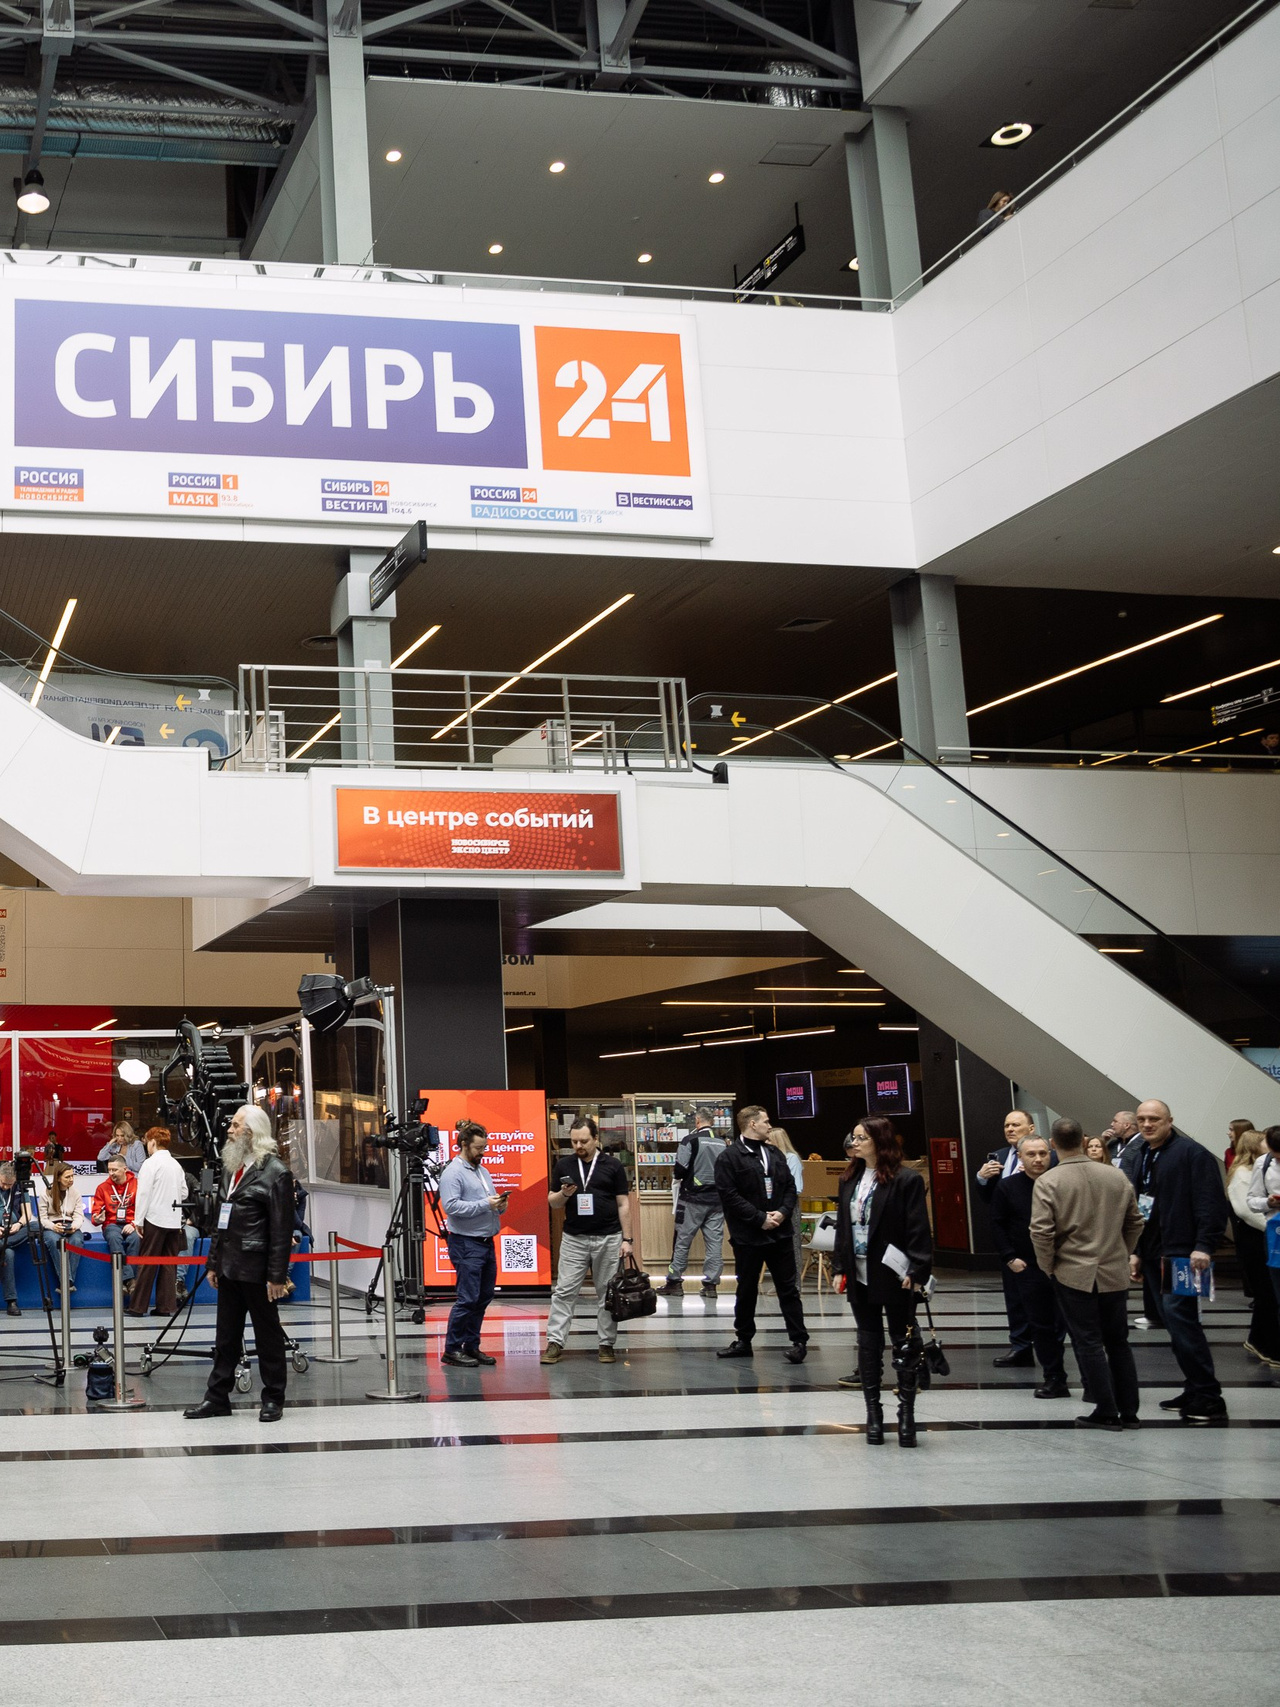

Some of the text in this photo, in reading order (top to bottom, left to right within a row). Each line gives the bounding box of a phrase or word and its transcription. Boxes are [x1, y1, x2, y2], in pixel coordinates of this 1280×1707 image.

[53, 332, 672, 443] СИБИРЬ 24
[20, 470, 78, 486] РОССИЯ
[172, 474, 234, 488] РОССИЯ 1
[324, 481, 389, 494] СИБИРЬ 24
[20, 493, 78, 501] НОВОСИБИРСК
[173, 493, 215, 505] МАЯК
[474, 488, 536, 501] РОССИЯ 24
[633, 496, 692, 509] ВЕСТИНСК.РФ
[475, 506, 574, 520] РАДИОРОССИИ
[362, 806, 594, 831] В центре событий
[451, 839, 510, 847] НОВОСИБИРСК
[451, 846, 510, 855] ЭКСПО ЦЕНТР
[786, 1086, 804, 1096] МАШ
[876, 1080, 898, 1091] МАШ
[452, 1130, 535, 1142] Пствуйте
[492, 1144, 535, 1153] центре
